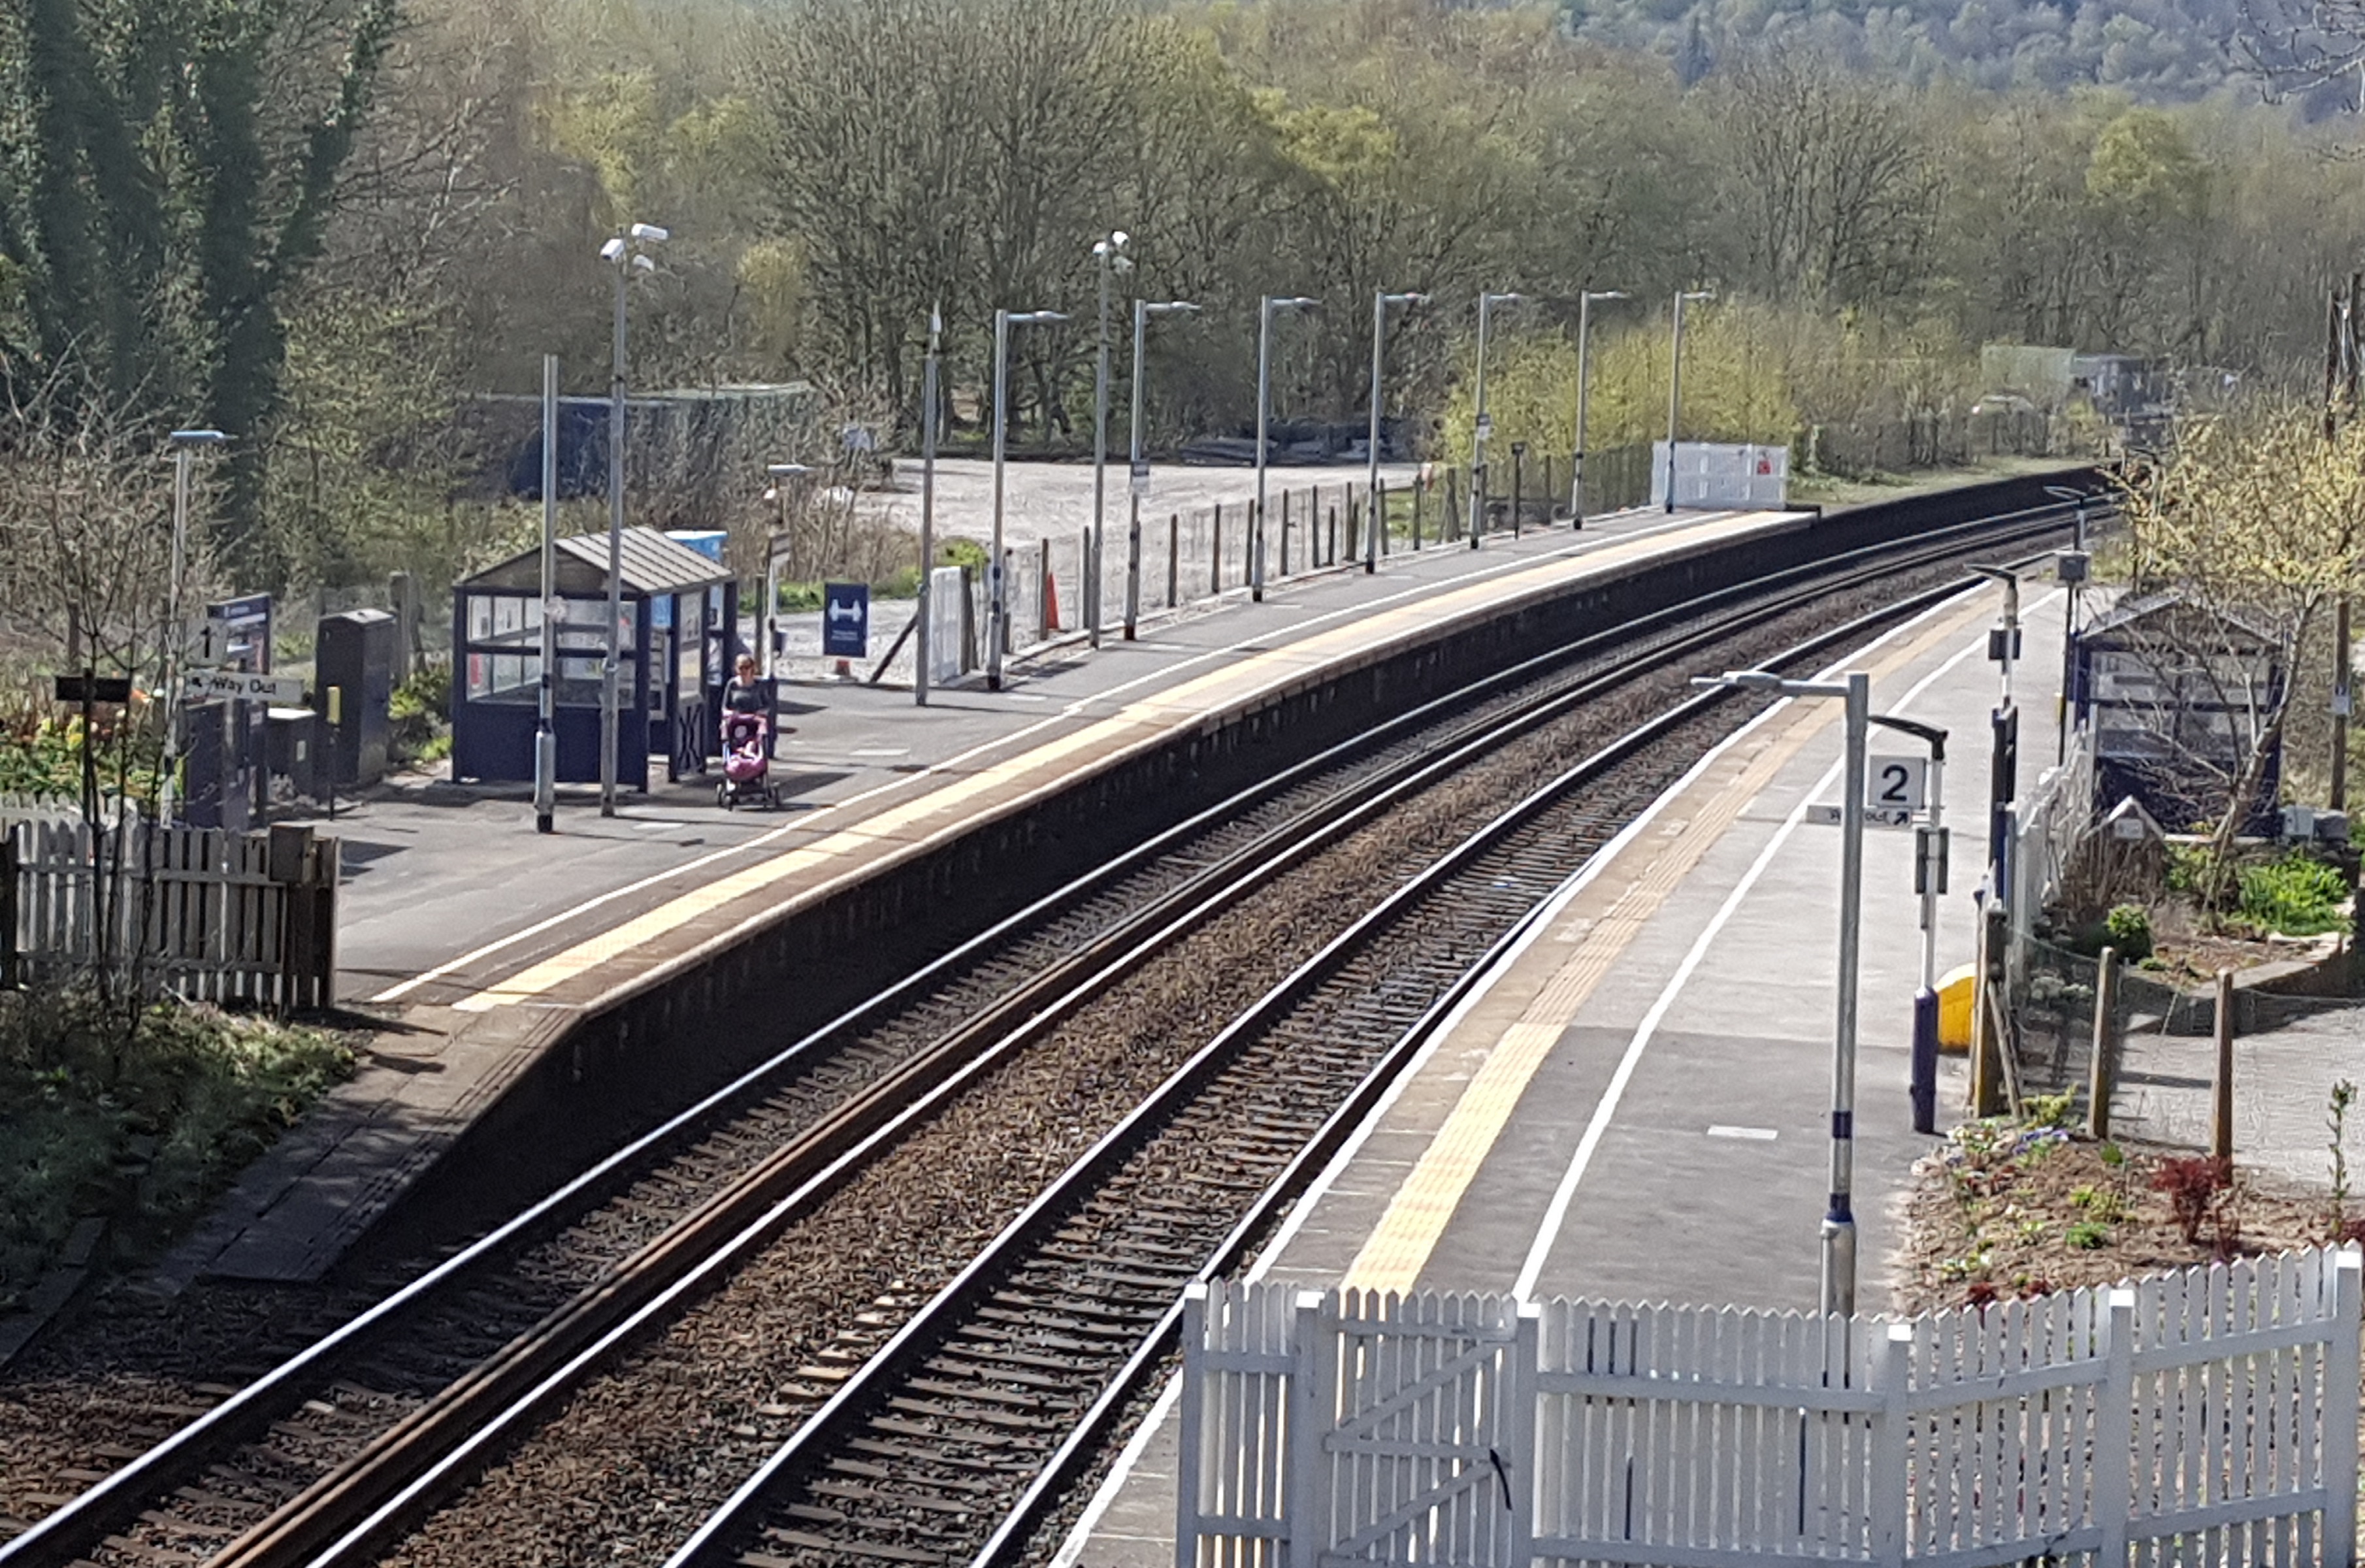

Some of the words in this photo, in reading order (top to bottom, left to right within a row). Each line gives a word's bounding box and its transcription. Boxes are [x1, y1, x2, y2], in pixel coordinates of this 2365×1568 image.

[200, 626, 211, 659] 1
[211, 677, 244, 694] Way
[250, 679, 276, 694] Out
[1881, 764, 1909, 802] 2
